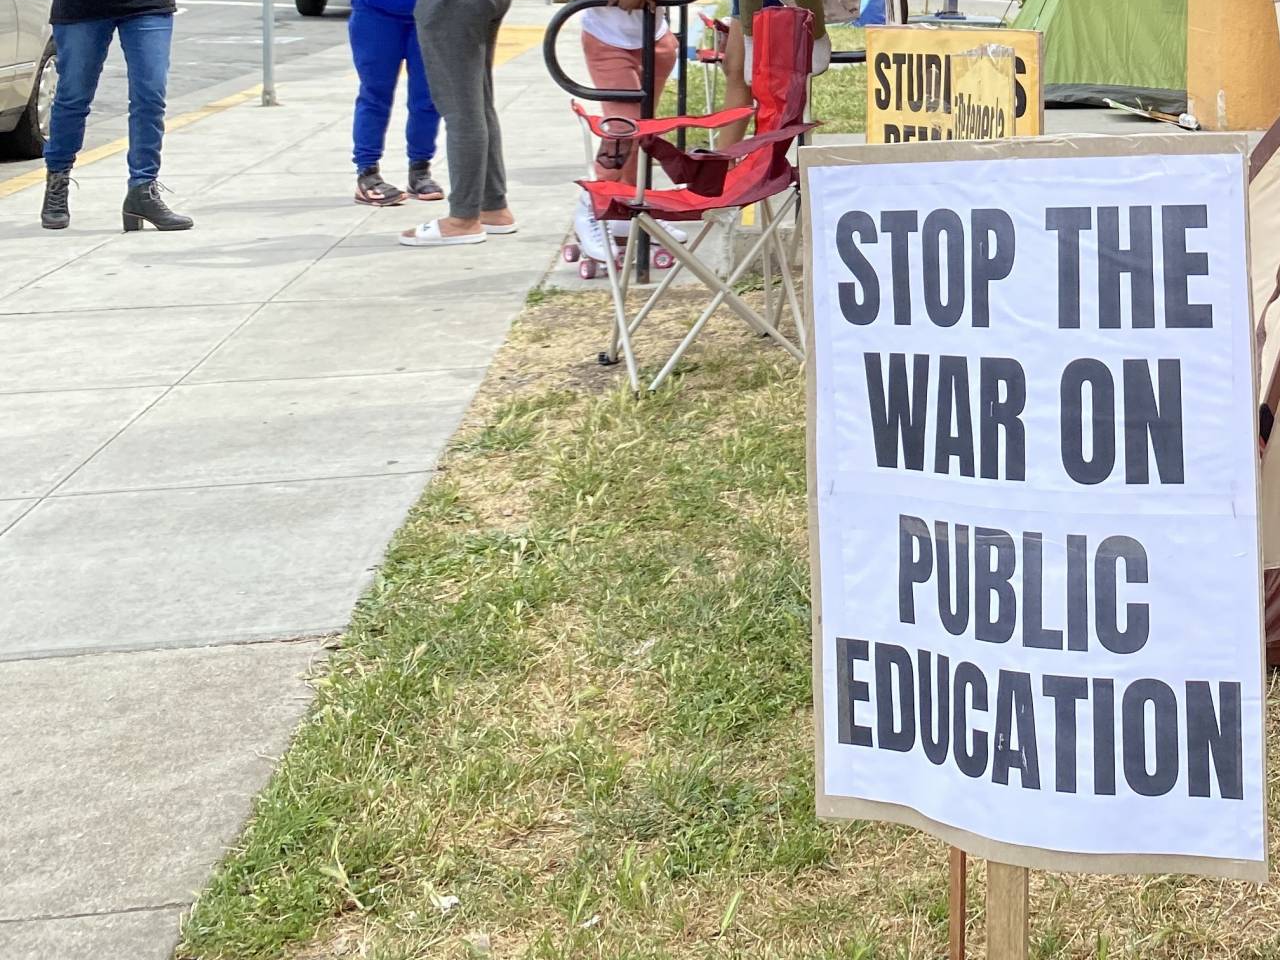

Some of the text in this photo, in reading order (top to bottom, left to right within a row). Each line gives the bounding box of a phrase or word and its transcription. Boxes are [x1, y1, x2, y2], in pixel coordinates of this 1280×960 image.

[875, 52, 1027, 119] STUDS
[836, 204, 1213, 329] STOP THE
[863, 352, 1185, 485] WAR ON
[899, 514, 1150, 654] PUBLIC
[836, 637, 1244, 800] EDUCATION
